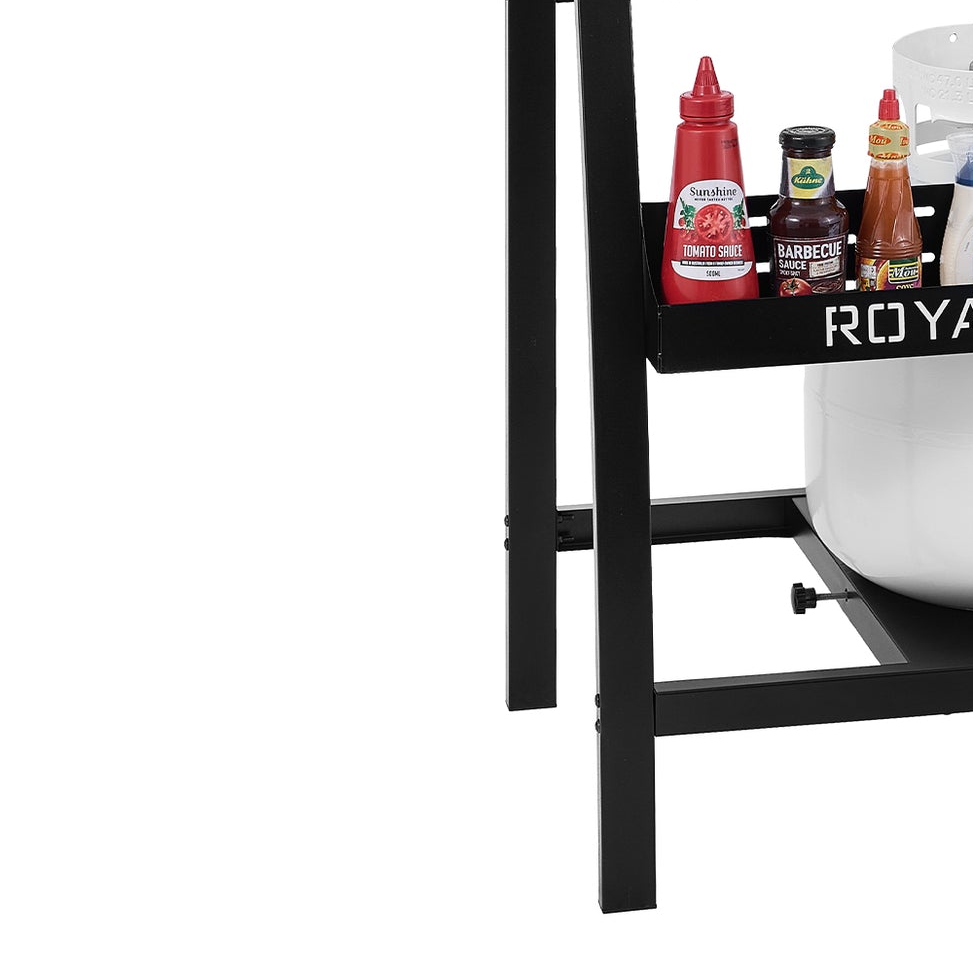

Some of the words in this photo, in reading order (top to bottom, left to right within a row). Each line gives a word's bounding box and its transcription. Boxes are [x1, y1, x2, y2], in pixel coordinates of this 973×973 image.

[793, 176, 823, 184] Kühne
[689, 186, 738, 197] Sunshine
[683, 244, 716, 257] TOMATO
[718, 244, 743, 257] SAUCE
[777, 240, 843, 260] BARBECUE
[778, 259, 807, 270] SAUCE
